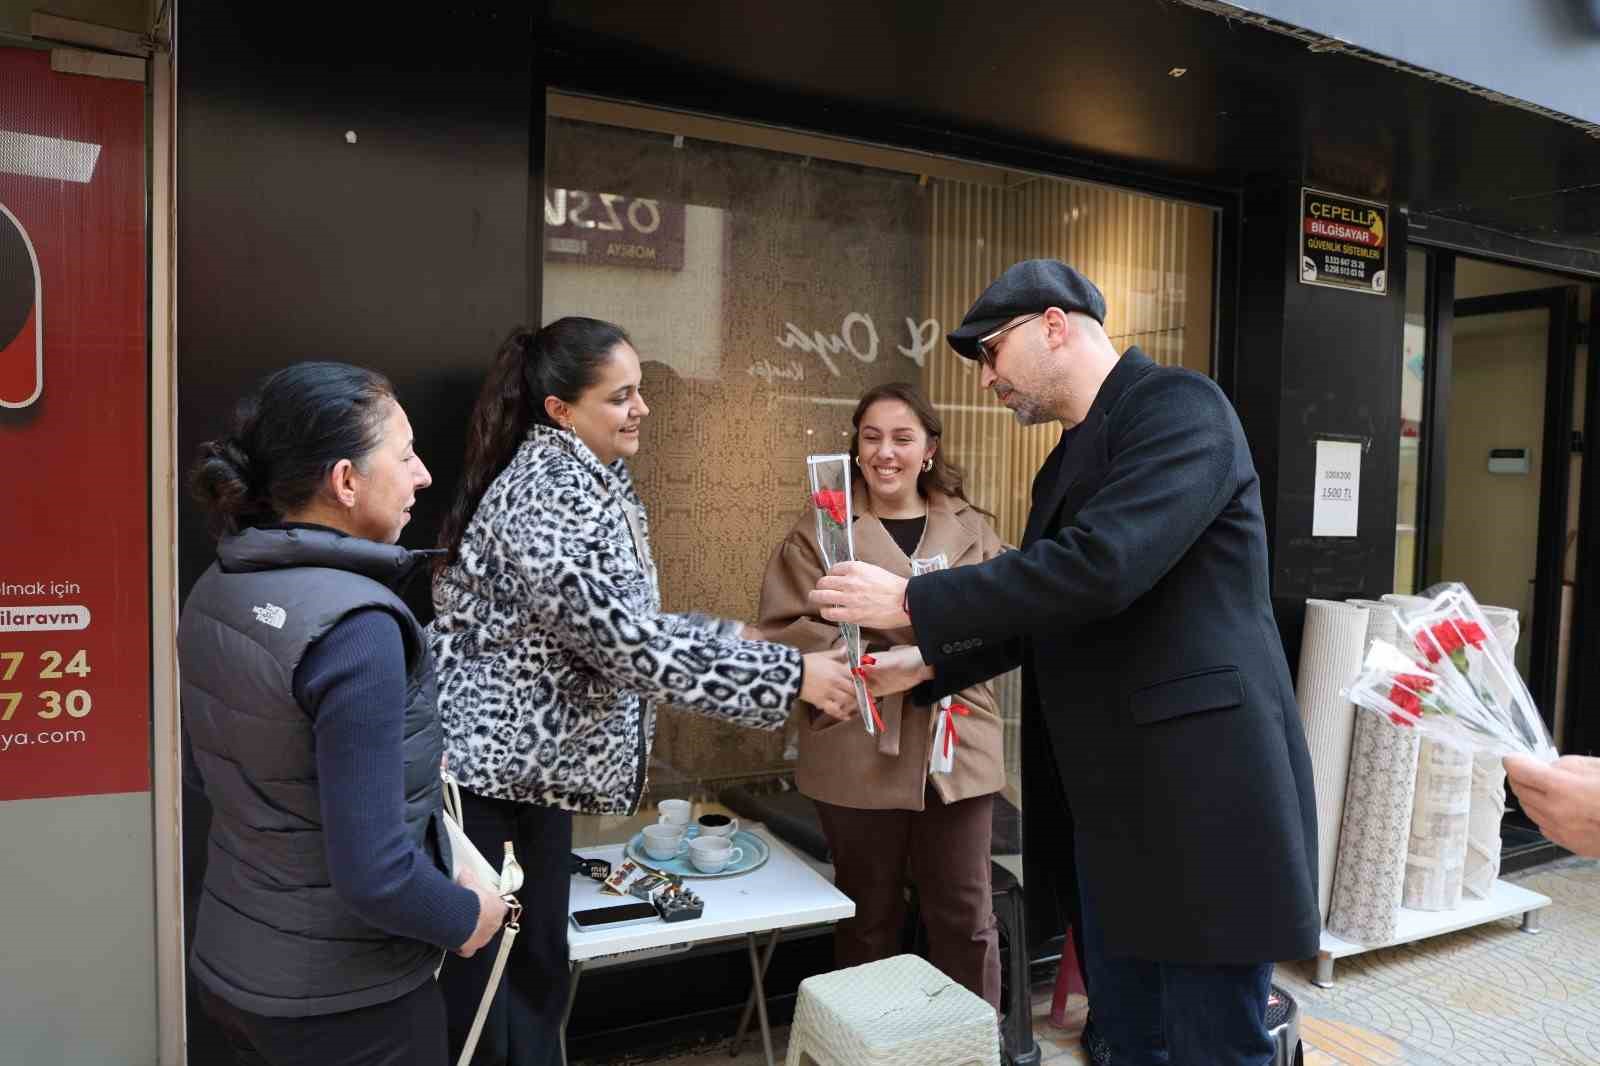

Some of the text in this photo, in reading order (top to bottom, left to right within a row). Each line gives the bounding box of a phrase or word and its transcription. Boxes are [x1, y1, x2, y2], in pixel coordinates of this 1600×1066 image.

[1311, 220, 1369, 242] BİLGİSAYAR
[0, 580, 81, 598] lmak için
[39, 650, 91, 679] 24
[37, 689, 92, 719] 30
[0, 730, 86, 751] ya.com
